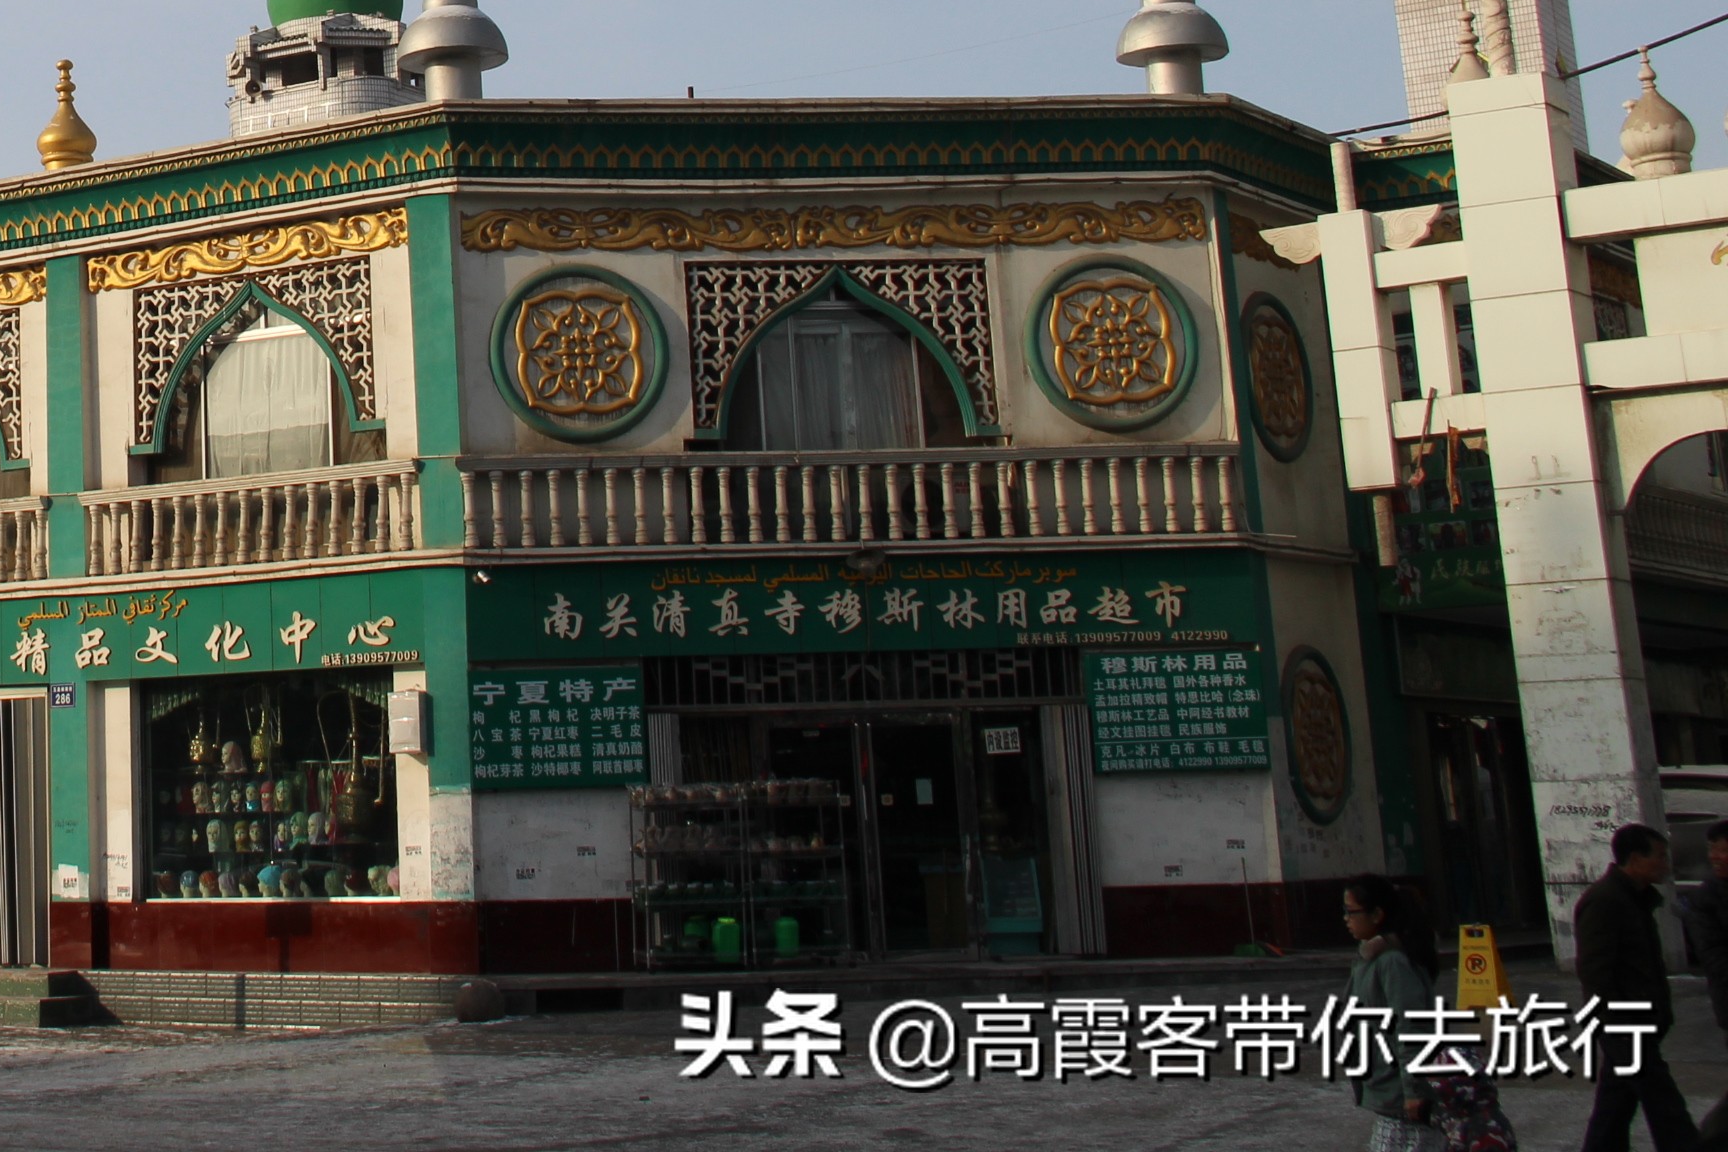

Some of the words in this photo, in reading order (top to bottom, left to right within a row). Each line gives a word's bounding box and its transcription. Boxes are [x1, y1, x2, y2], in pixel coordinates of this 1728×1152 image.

[543, 580, 1190, 639] 南关清真寺穆斯林用品超市
[1171, 630, 1228, 642] 4122990
[1100, 653, 1247, 674] 穆斯林用品
[1173, 673, 1247, 689] 国外各种香水
[55, 693, 71, 705] 286
[472, 677, 637, 705] 宁夏特产
[590, 705, 641, 721] 决明子茶
[1096, 708, 1170, 724] 穆斯林工艺品
[529, 725, 579, 741] 宁夏红枣
[1179, 721, 1228, 737] 民族服饰
